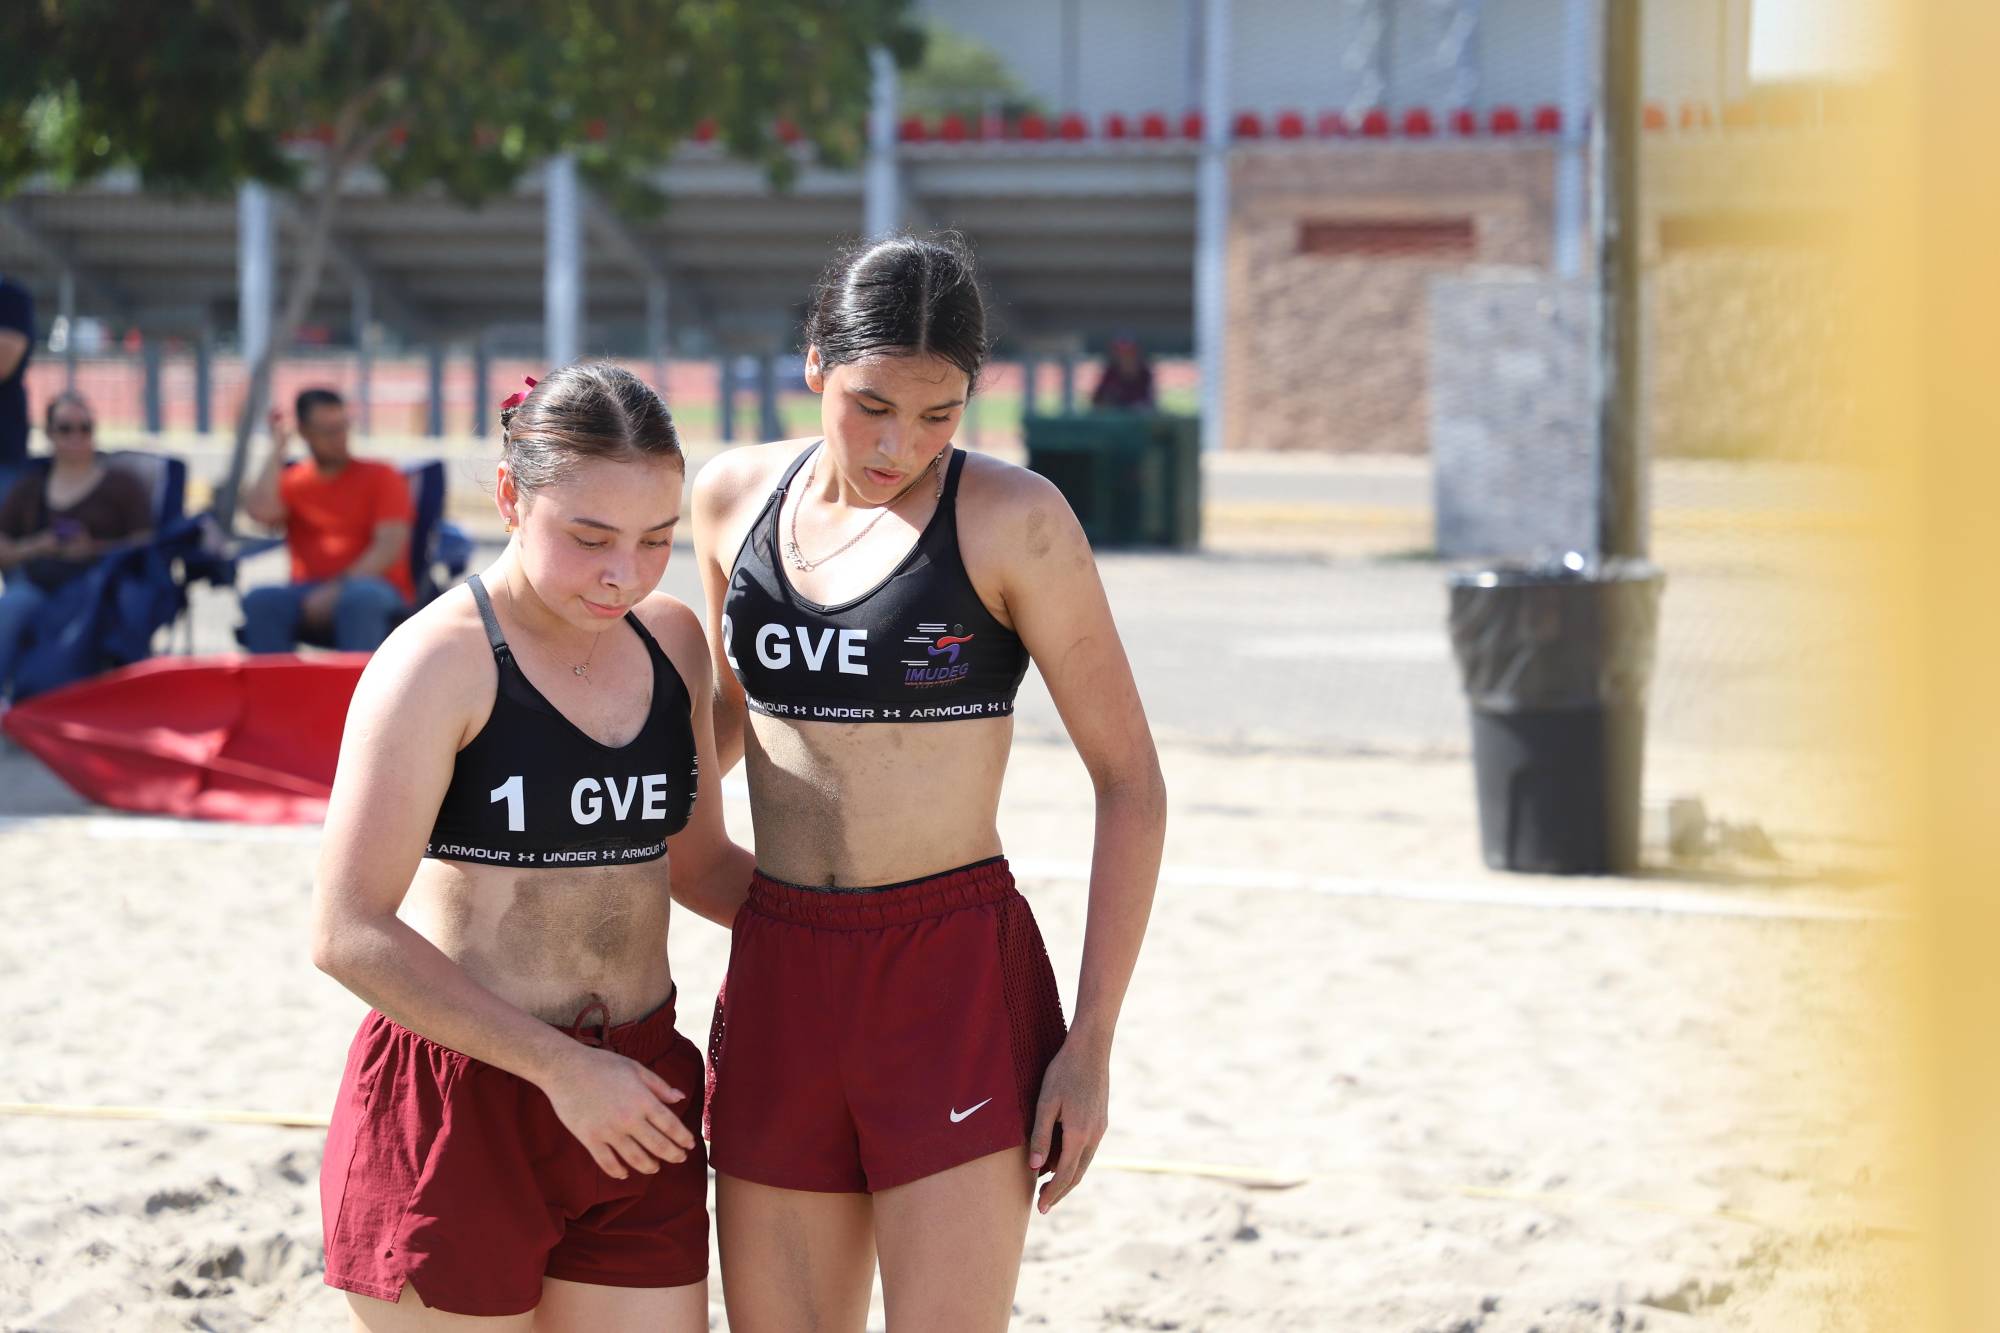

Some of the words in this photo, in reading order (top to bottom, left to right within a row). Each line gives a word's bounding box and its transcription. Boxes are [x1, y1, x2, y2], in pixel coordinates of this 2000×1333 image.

[755, 622, 869, 676] GVE
[905, 663, 969, 681] IMUDEG
[813, 706, 875, 718] UNDER
[910, 703, 983, 718] ARMOUR
[490, 775, 526, 832] 1
[570, 773, 667, 825] GVE
[438, 844, 511, 861] ARMOUR
[543, 851, 597, 862] UNDER
[621, 843, 660, 859] ARMOUR
